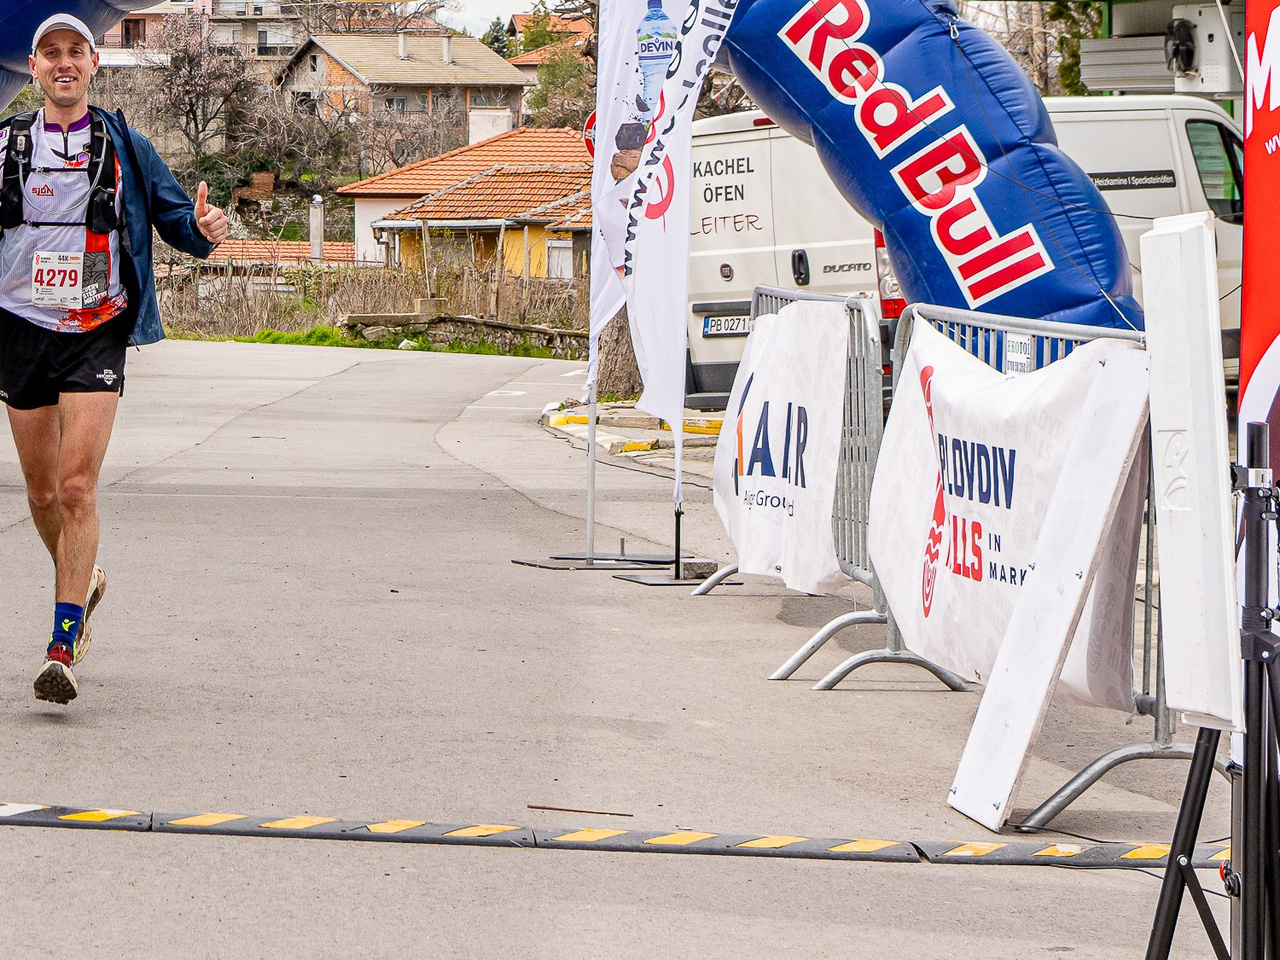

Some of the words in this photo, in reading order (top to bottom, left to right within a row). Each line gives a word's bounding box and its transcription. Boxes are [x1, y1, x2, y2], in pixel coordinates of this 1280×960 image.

[640, 41, 673, 53] DEVIN
[693, 157, 754, 178] KACHEL
[703, 183, 744, 203] ÖFEN
[898, 131, 1046, 301] Bull
[823, 263, 872, 274] DUCATO
[34, 269, 78, 287] 4279
[709, 318, 722, 332] PB
[724, 317, 746, 331] 0271
[989, 533, 1001, 552] IN
